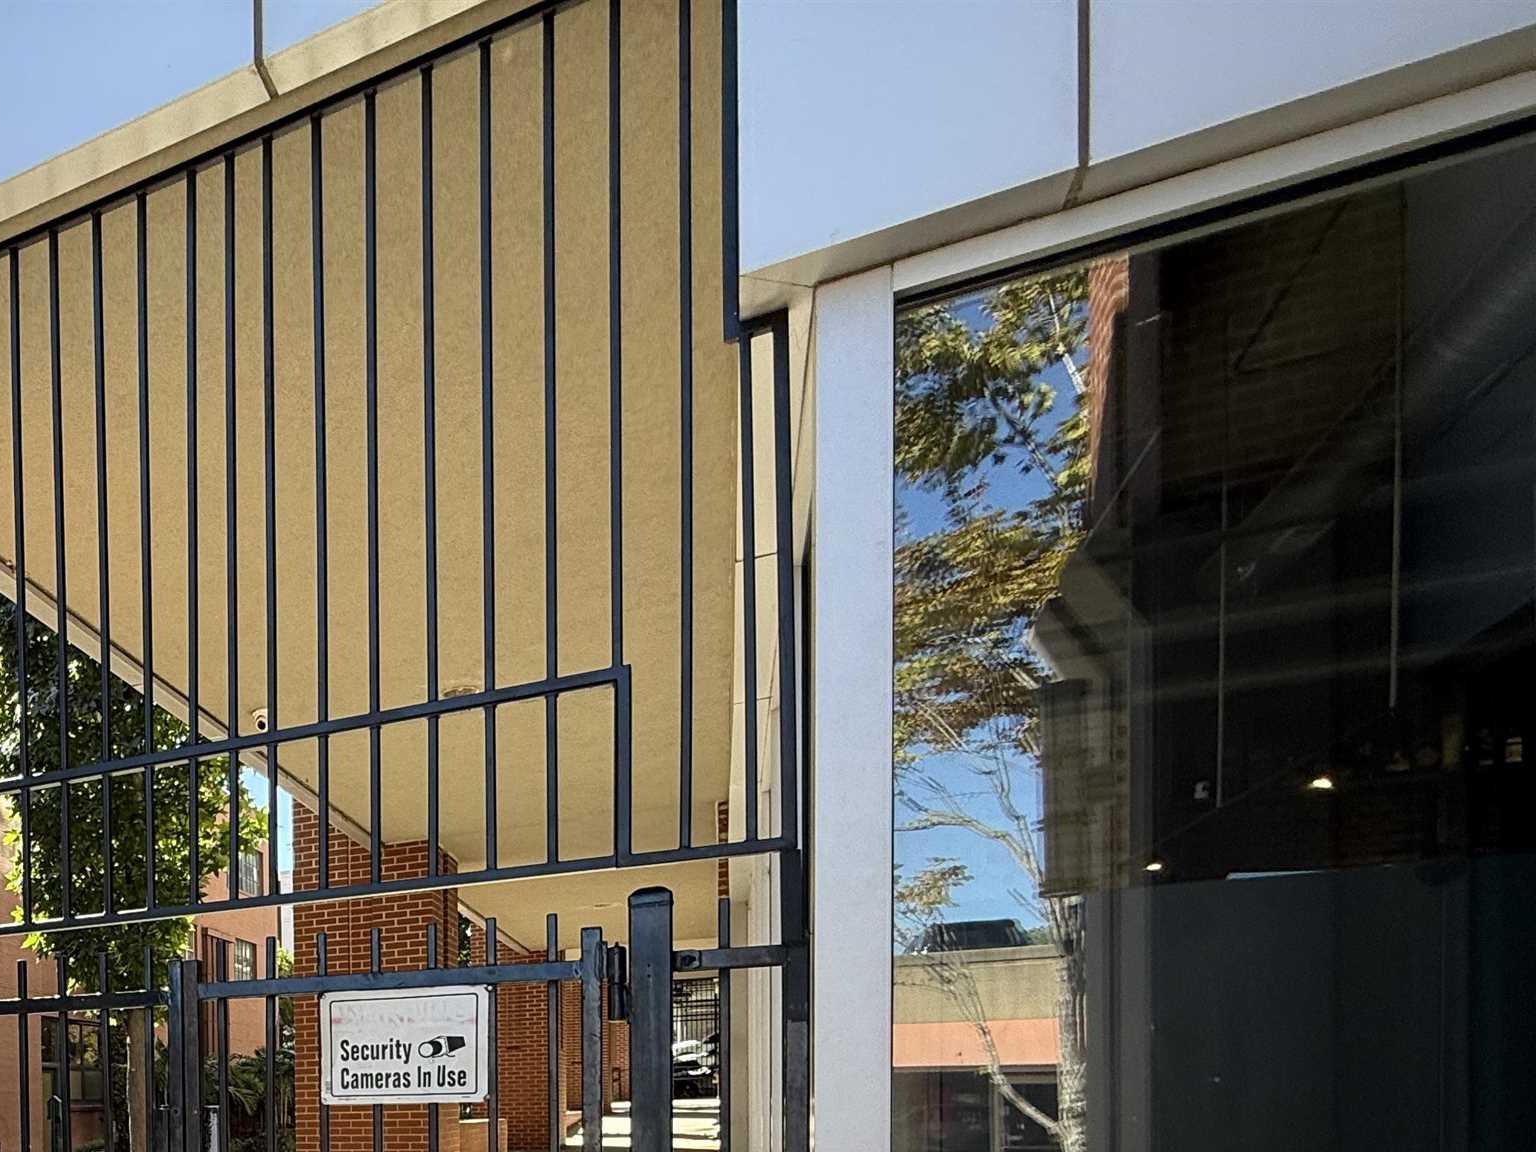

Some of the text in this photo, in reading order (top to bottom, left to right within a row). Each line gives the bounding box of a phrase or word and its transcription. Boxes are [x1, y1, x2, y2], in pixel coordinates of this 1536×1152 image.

[340, 1038, 412, 1064] Security
[340, 1067, 411, 1090] Cameras
[417, 1066, 431, 1087] In
[437, 1064, 467, 1087] Use
